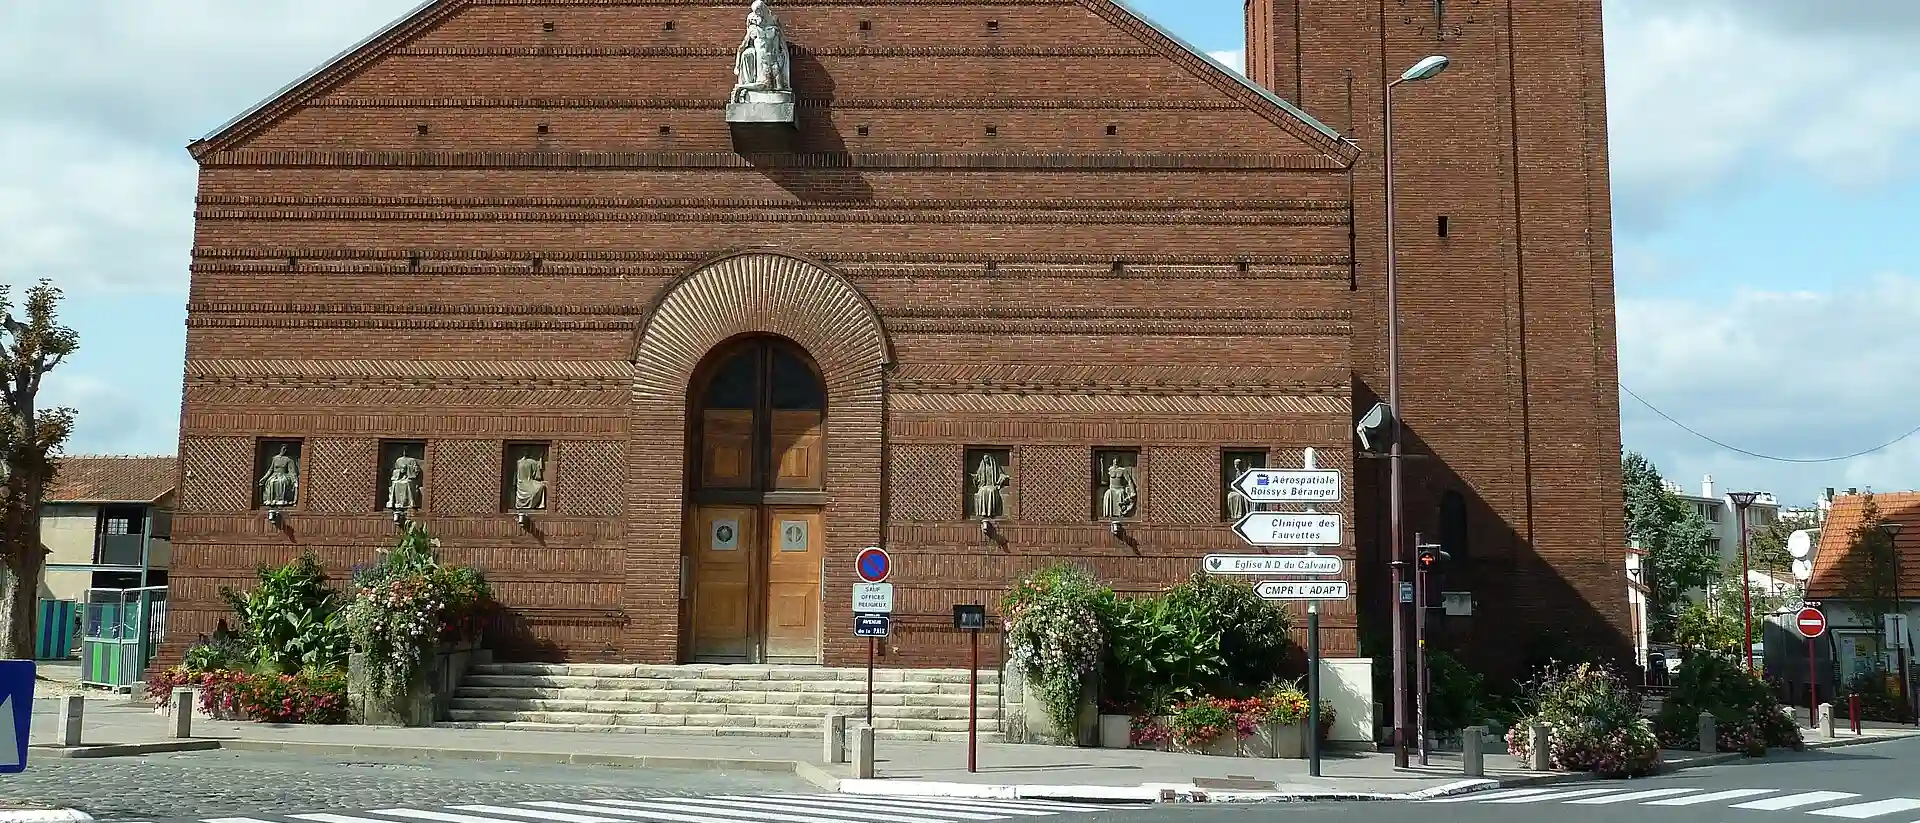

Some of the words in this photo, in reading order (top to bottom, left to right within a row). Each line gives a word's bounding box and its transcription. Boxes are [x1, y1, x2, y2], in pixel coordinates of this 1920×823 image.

[1272, 475, 1335, 486] Aérospatiale
[1250, 486, 1287, 497] Roissys
[1291, 487, 1336, 498] Béranger
[1271, 518, 1313, 530] Clinique
[1318, 519, 1335, 528] des
[1271, 530, 1320, 540] Fauvettes
[1284, 561, 1295, 569] du
[1297, 560, 1336, 570] Calvaire
[1265, 586, 1294, 595] CMPR
